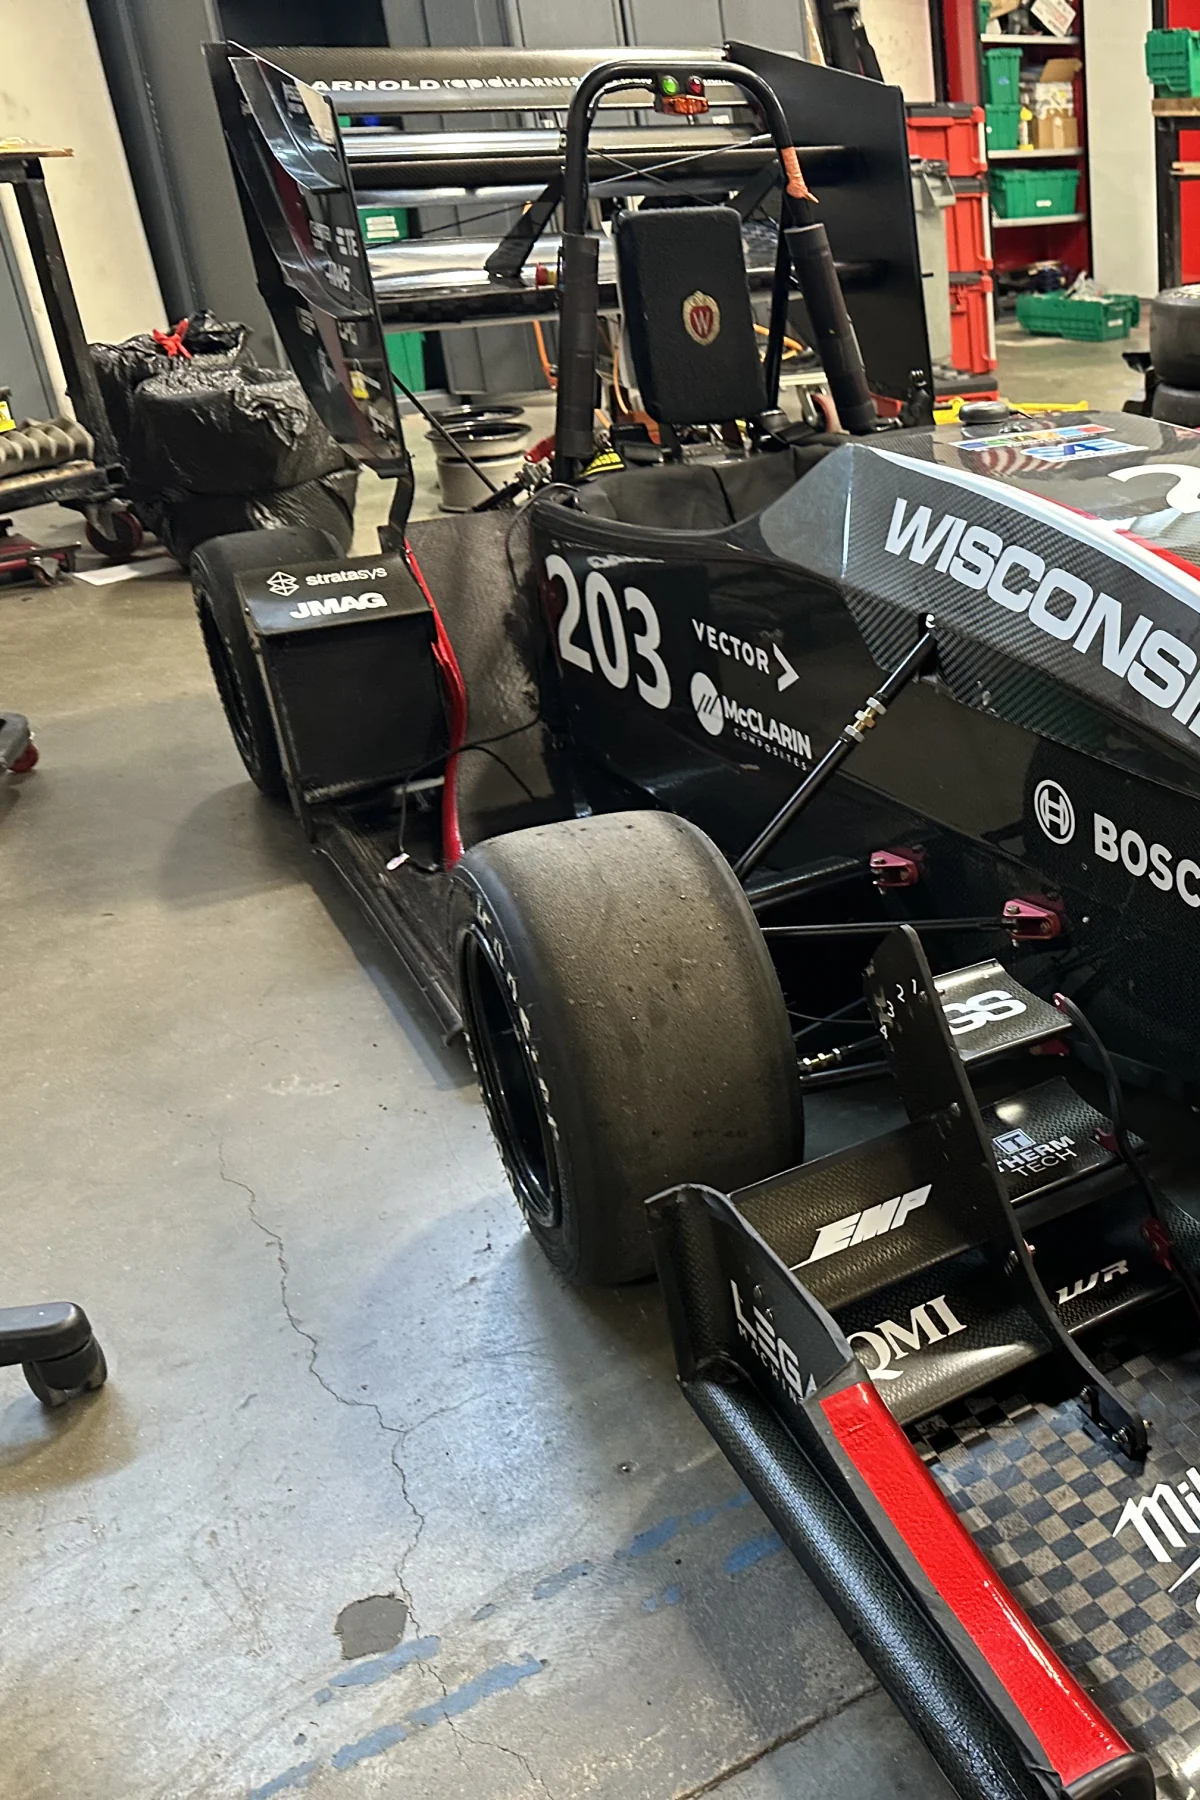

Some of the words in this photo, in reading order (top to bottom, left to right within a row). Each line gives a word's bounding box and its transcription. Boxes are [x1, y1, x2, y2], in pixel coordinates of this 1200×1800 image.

[312, 79, 441, 92] ARNOLD
[305, 567, 388, 586] stratasys
[290, 592, 389, 619] JMAG
[545, 553, 672, 710] 203
[691, 617, 770, 675] VECTOR
[722, 694, 812, 760] McCLARIN
[734, 728, 807, 771] COMPOSITES
[1011, 1148, 1077, 1177] TECH
[847, 1295, 968, 1381] QMI
